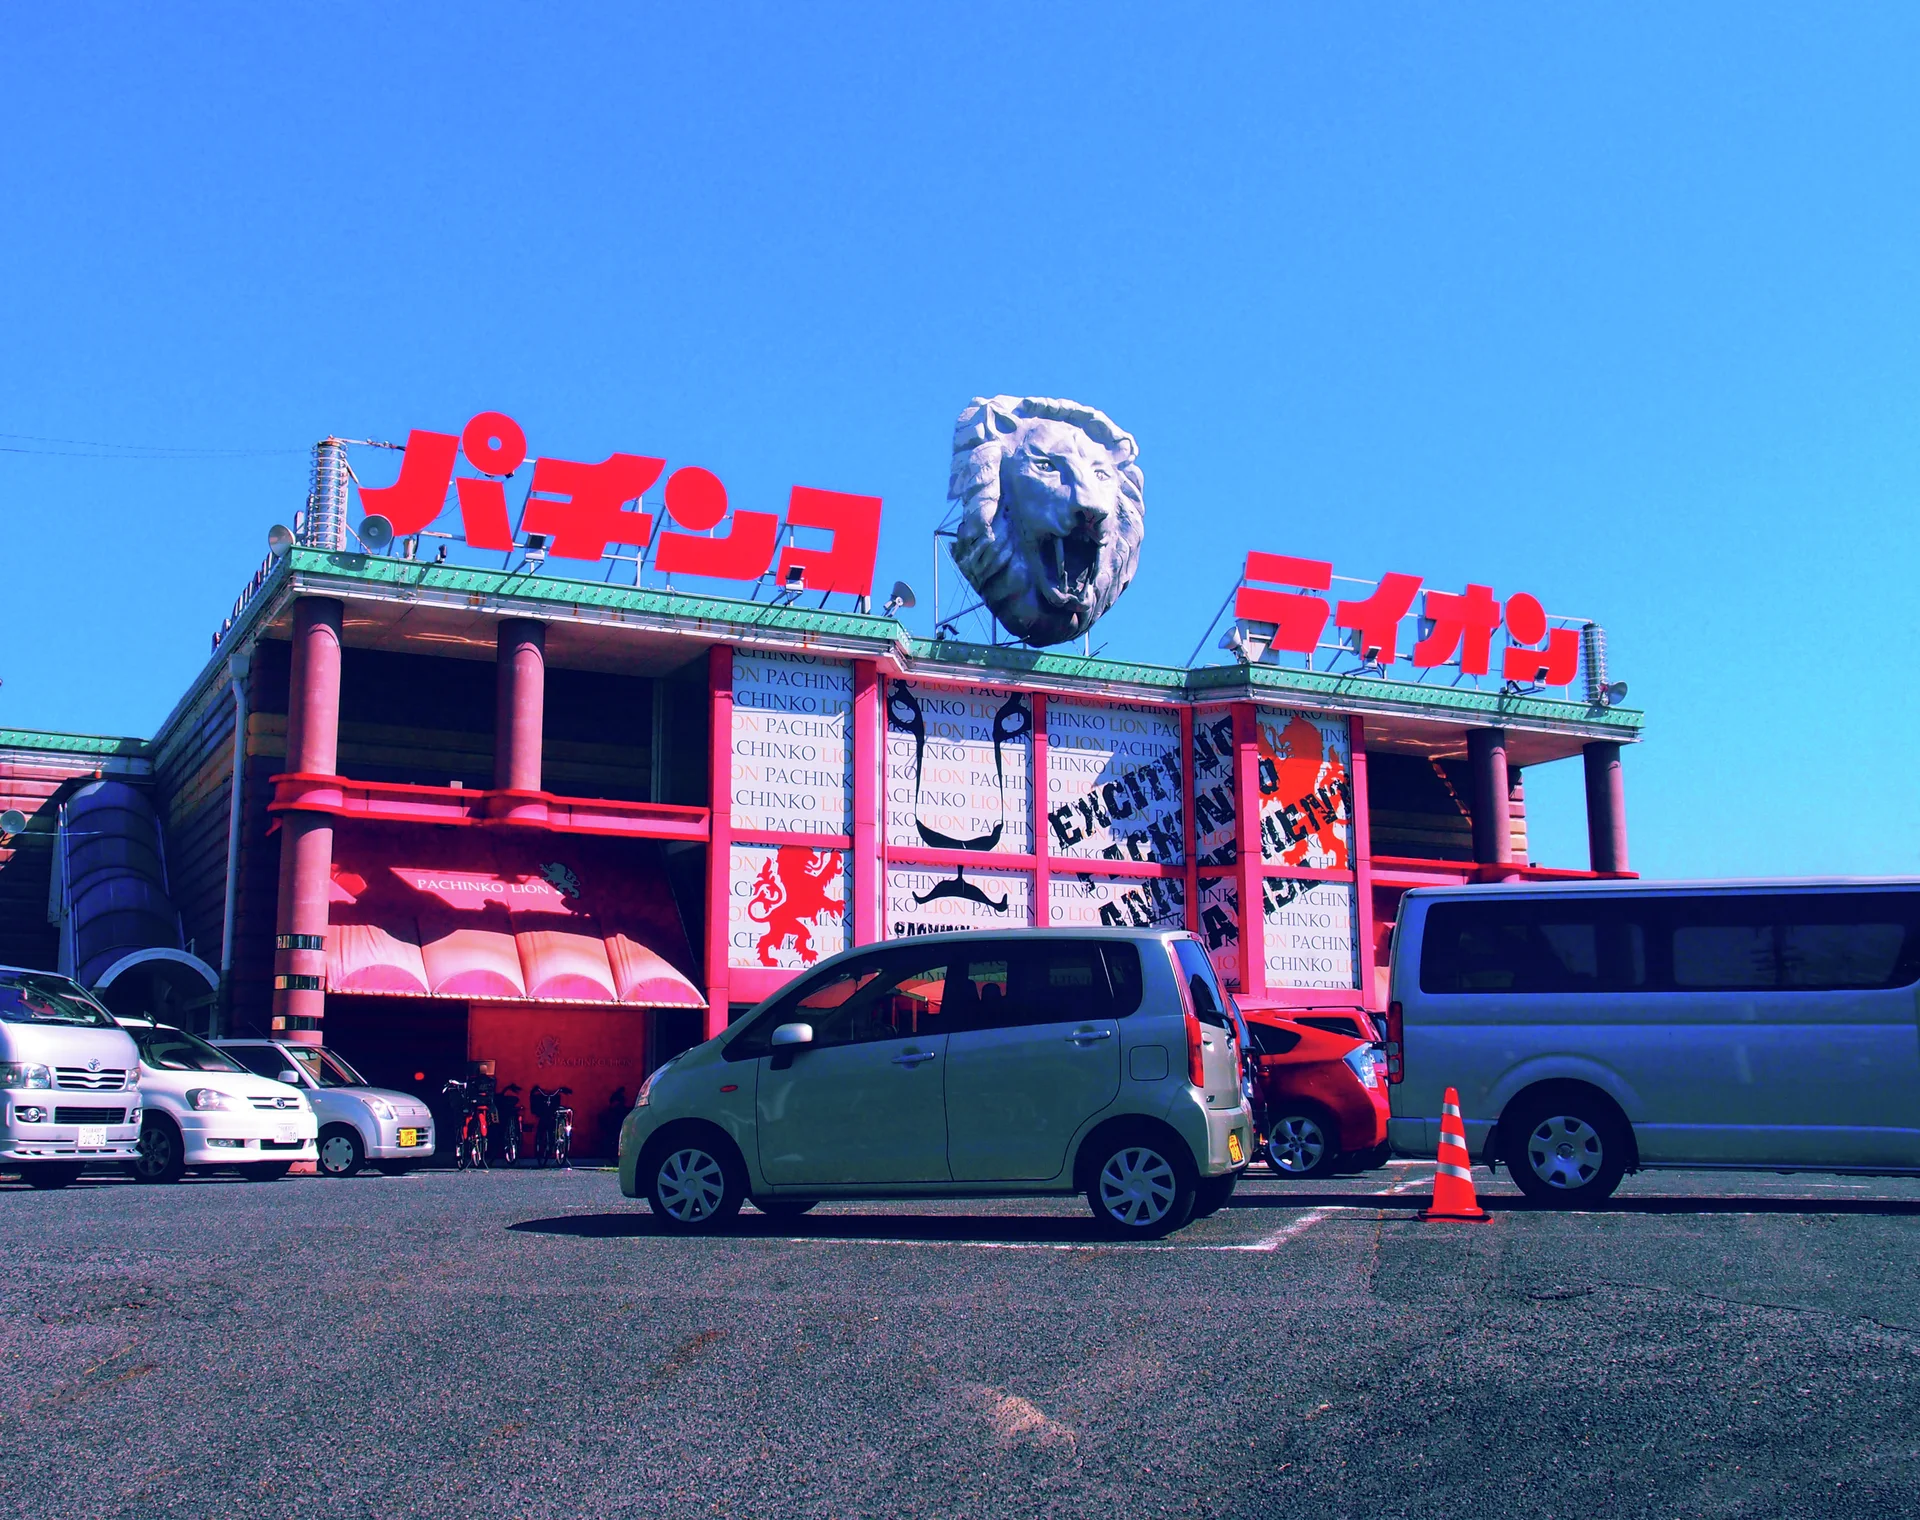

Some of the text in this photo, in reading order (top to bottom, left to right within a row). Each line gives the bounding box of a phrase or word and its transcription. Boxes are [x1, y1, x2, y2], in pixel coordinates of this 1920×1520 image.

[358, 411, 883, 596] パチンコ
[1234, 550, 1580, 686] ライオン
[1109, 717, 1148, 736] LION
[731, 739, 816, 762] CHINKO
[923, 767, 965, 785] LION
[731, 789, 816, 811] CHINKO
[417, 879, 549, 895] PACHINKO LION
